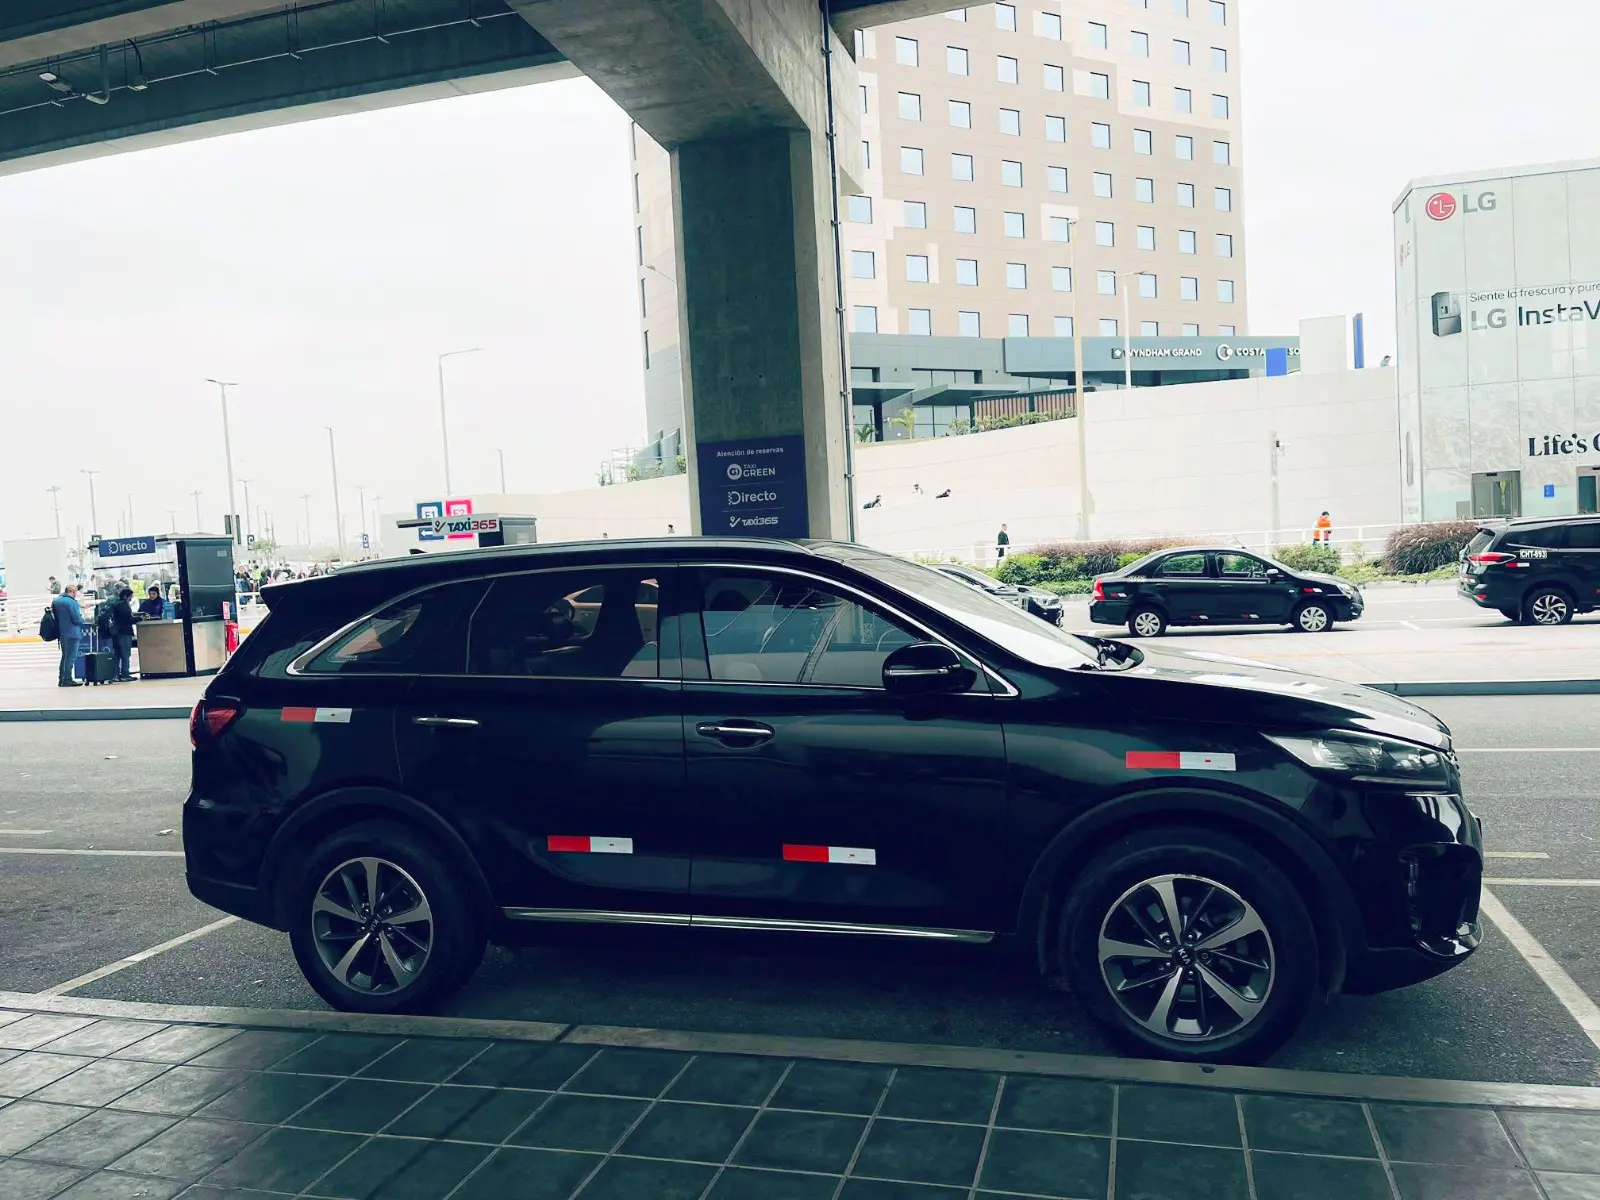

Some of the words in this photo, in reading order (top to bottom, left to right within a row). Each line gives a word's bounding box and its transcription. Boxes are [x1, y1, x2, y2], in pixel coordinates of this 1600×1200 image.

[1463, 192, 1496, 213] LG
[1470, 292, 1505, 302] Siente
[1507, 290, 1517, 299] la
[1520, 286, 1566, 297] frescura
[1568, 286, 1575, 295] y
[1471, 308, 1507, 330] LG
[1518, 300, 1600, 327] InstaV
[1172, 348, 1202, 357] GRAND
[1236, 347, 1265, 356] COSTA
[755, 447, 784, 455] reservas
[1529, 433, 1588, 456] Life's
[743, 467, 776, 477] GREEN
[728, 490, 777, 505] Directo
[108, 541, 148, 554] Directo
[1178, 948, 1191, 965] KIA
